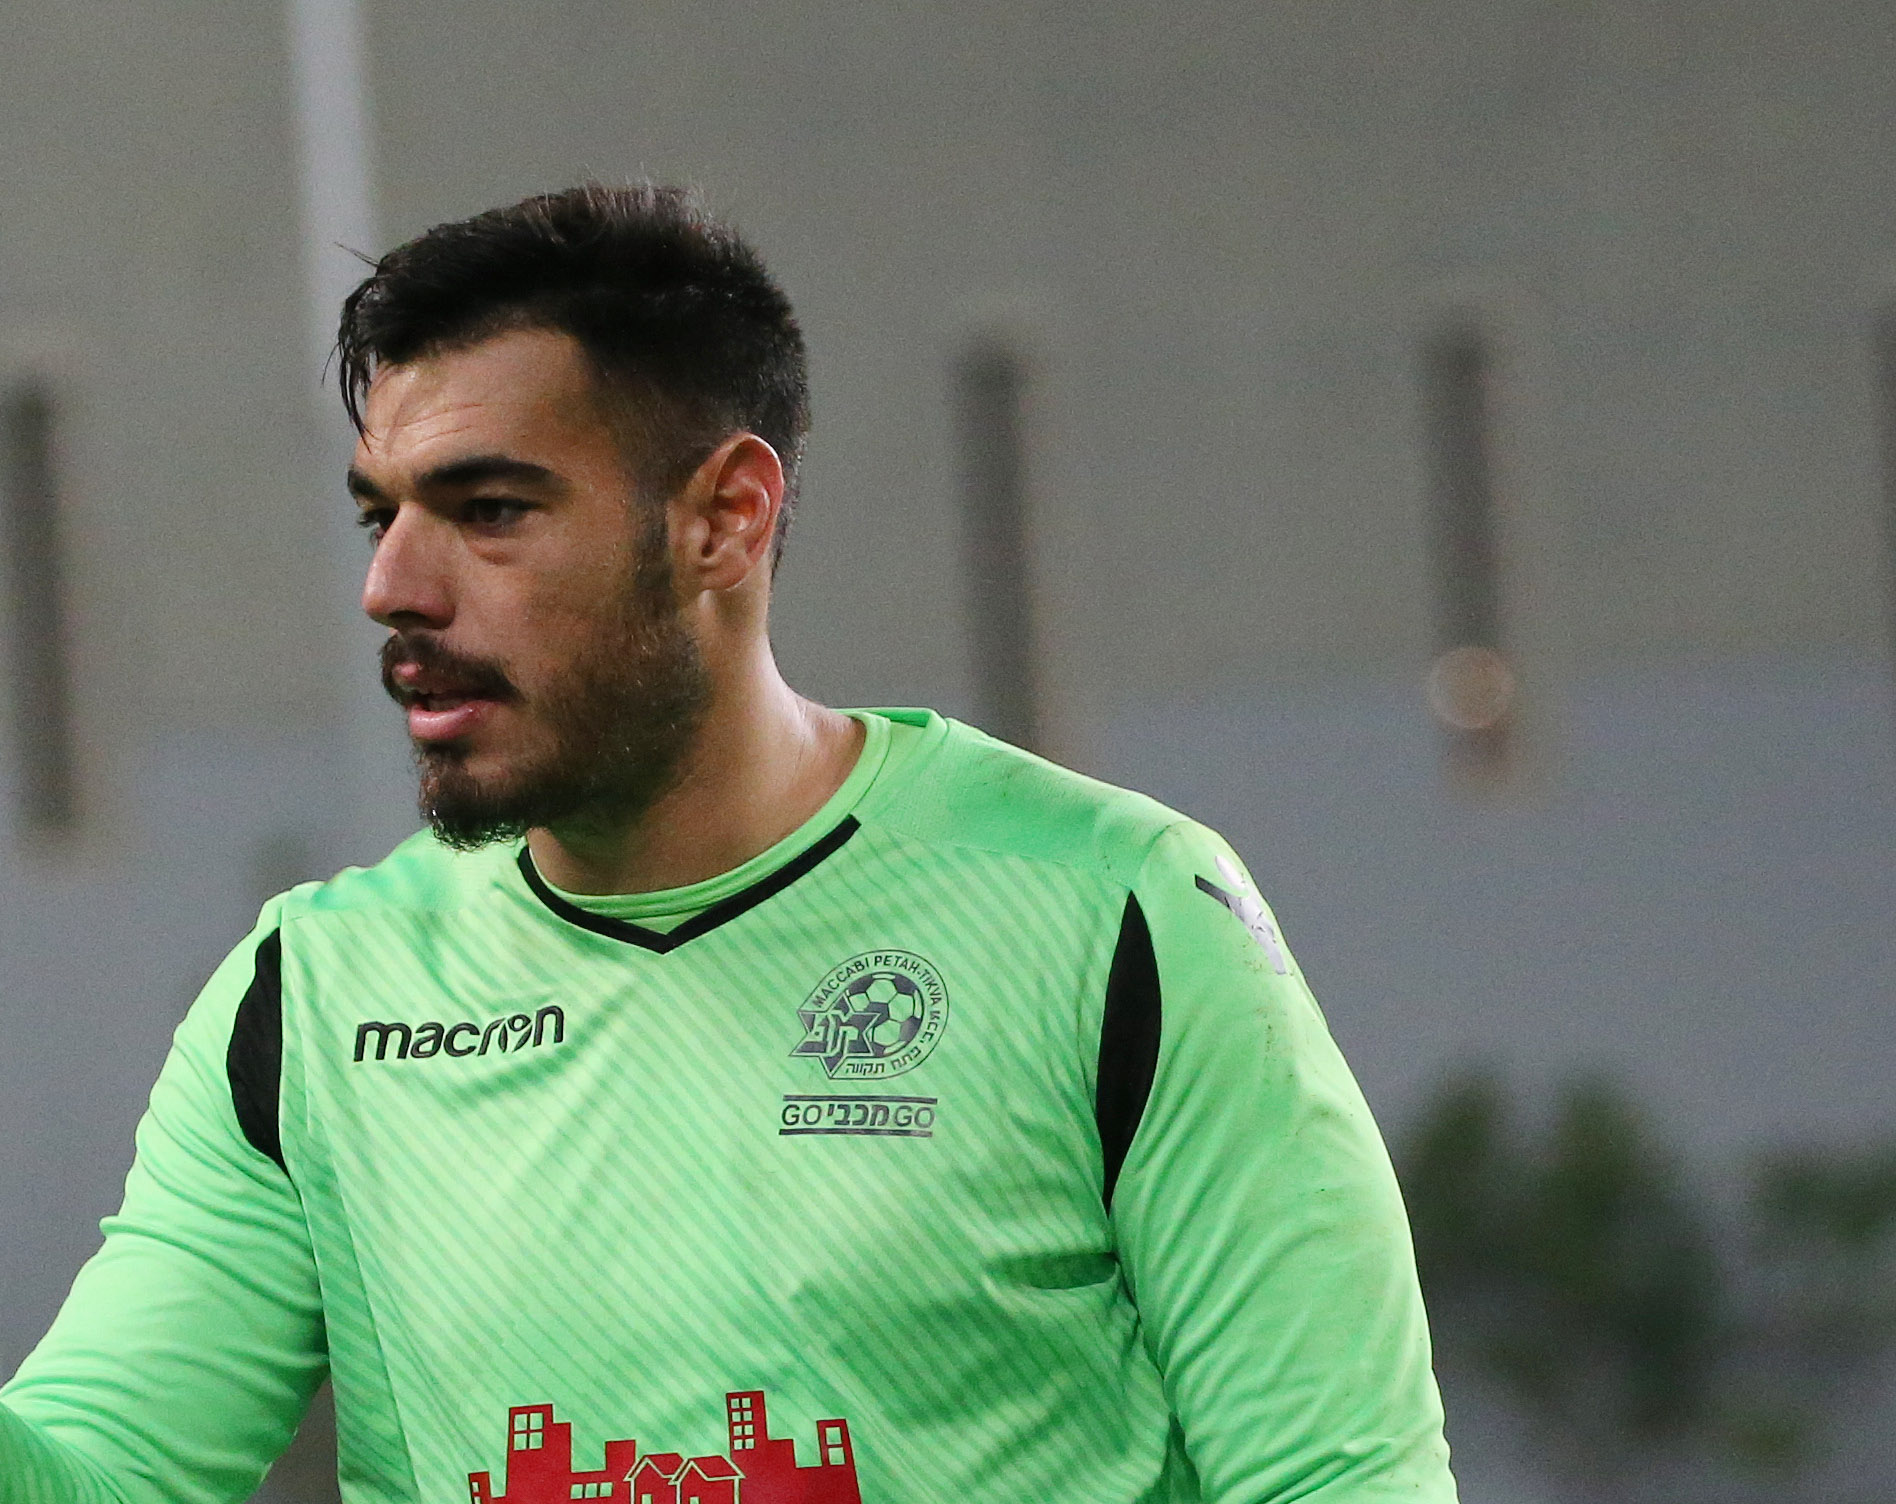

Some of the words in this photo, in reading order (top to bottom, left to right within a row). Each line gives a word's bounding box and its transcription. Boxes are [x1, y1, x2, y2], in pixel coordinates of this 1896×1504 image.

[812, 956, 870, 1008] MACCABI
[873, 954, 943, 1006] PETAH-TIKVA
[353, 1003, 565, 1063] macron
[844, 1062, 886, 1076] תקווה
[890, 1046, 922, 1071] פתח
